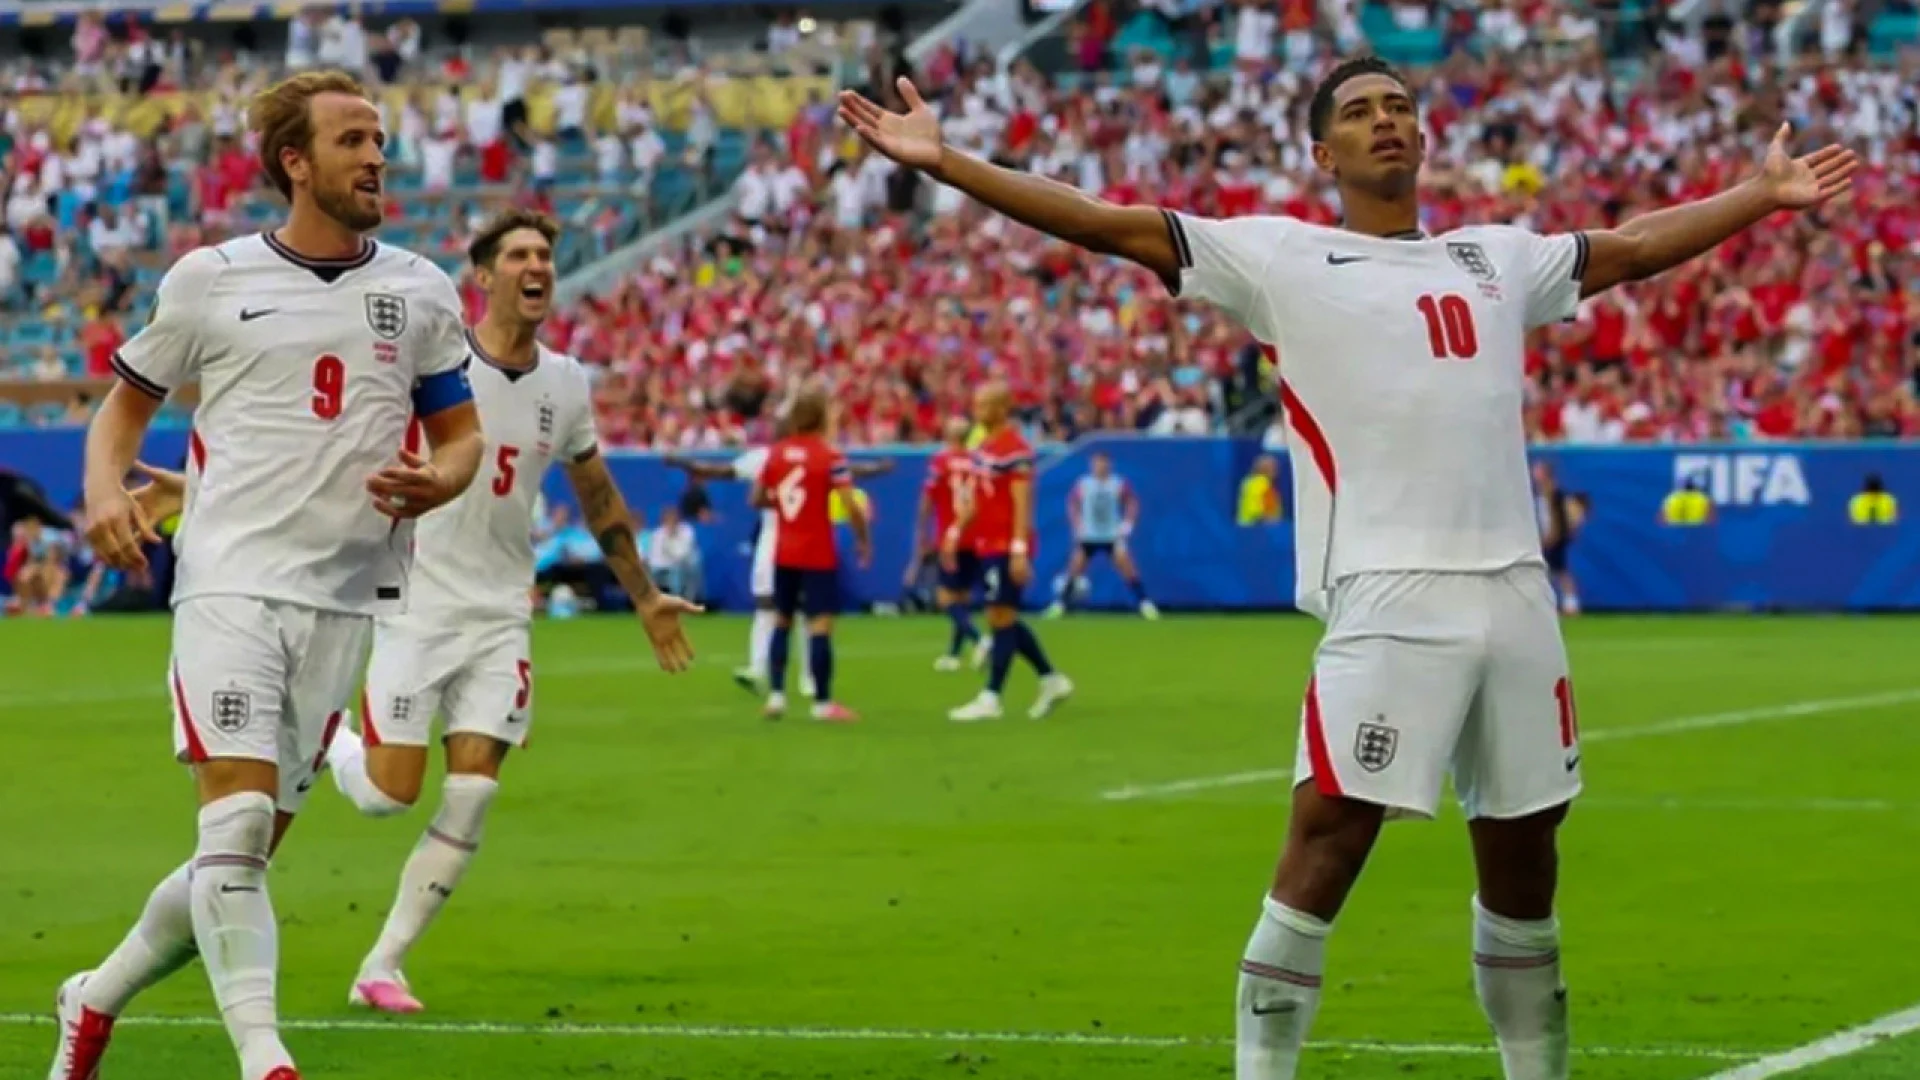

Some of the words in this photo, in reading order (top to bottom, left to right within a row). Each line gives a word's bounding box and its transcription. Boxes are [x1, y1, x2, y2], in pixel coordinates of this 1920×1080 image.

[1416, 294, 1478, 359] 10
[312, 354, 344, 420] 9
[493, 445, 520, 496] 5
[777, 465, 807, 522] 6
[1674, 454, 1810, 505] FIFA
[1554, 676, 1579, 748] 1
